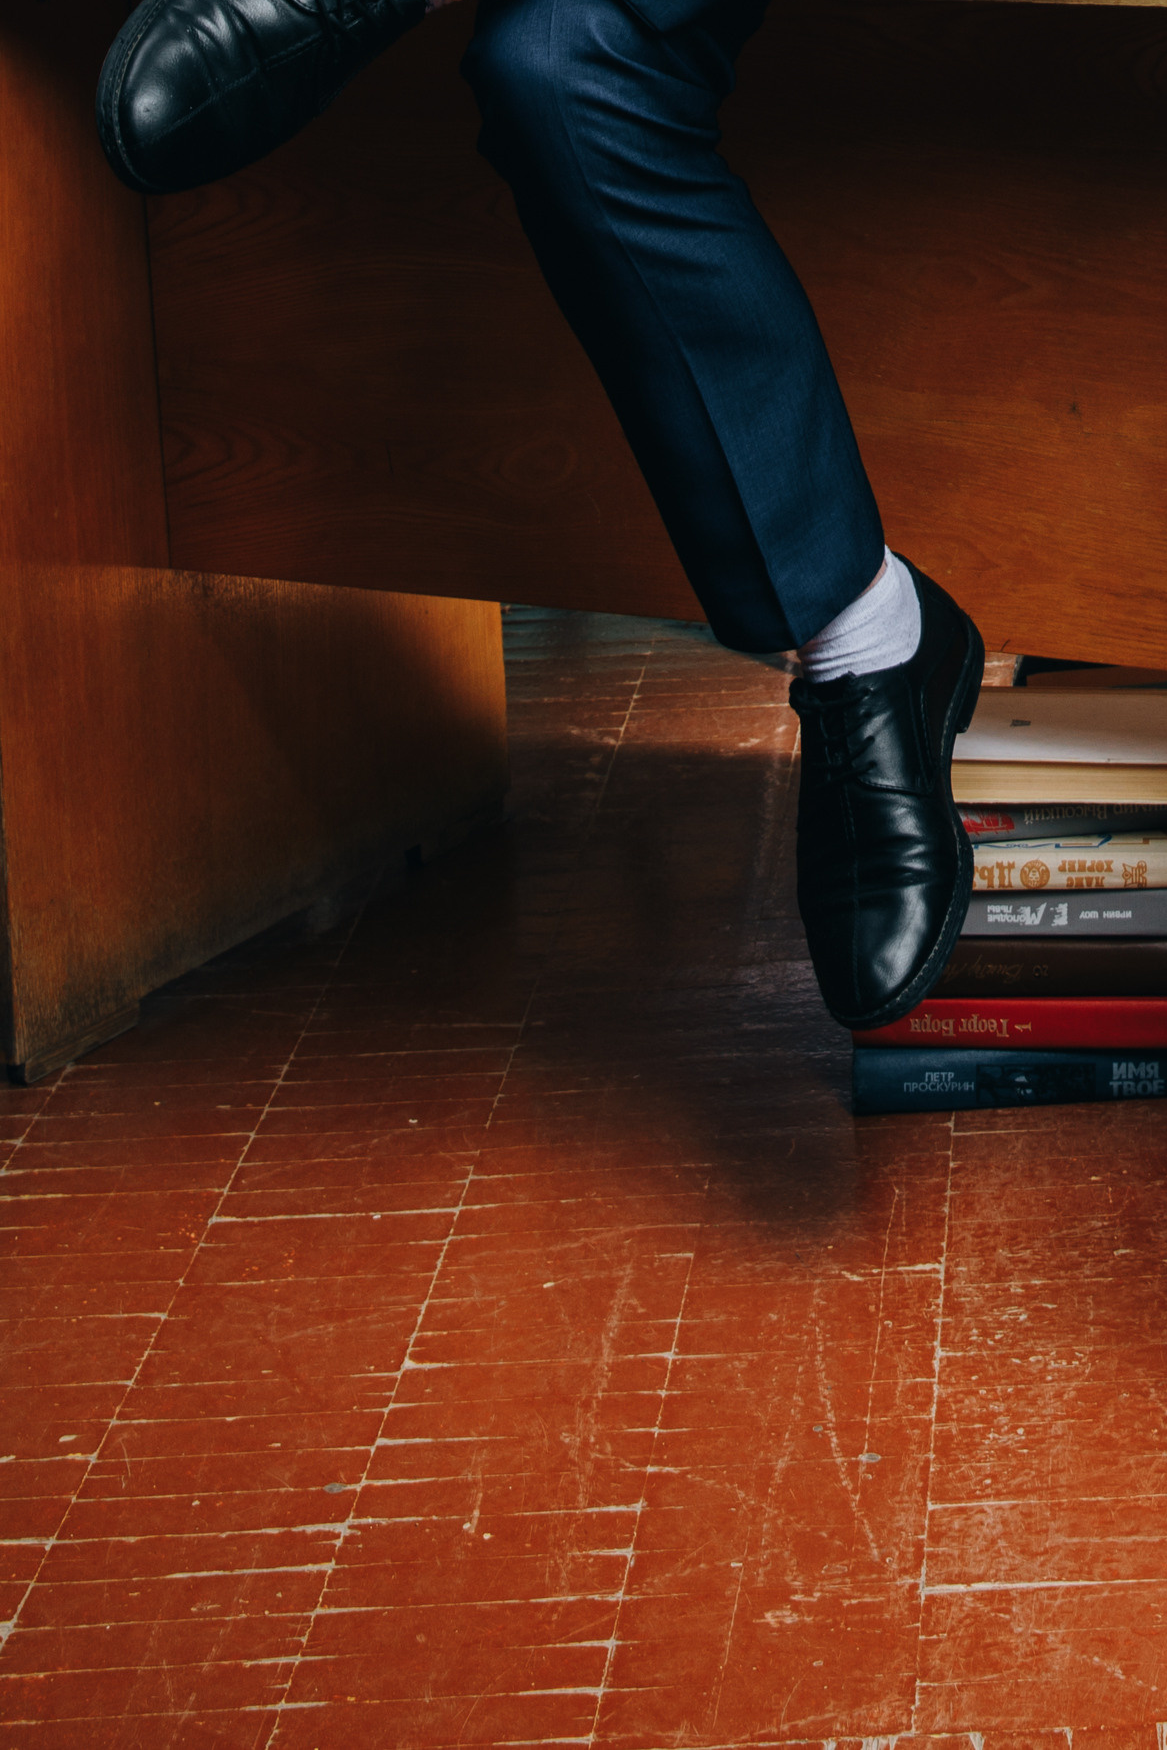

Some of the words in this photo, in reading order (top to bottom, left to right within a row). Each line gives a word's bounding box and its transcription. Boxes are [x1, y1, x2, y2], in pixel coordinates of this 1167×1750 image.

[1058, 859, 1115, 873] ХОРНЕР
[1067, 873, 1107, 888] ЛАНС
[1079, 910, 1099, 919] ШОУ
[1103, 909, 1133, 919] ИРВИН
[910, 1013, 956, 1037] Борн
[959, 1017, 1010, 1037] Георг
[924, 1070, 956, 1082] ПЕТР
[1112, 1062, 1160, 1080] ИМЯ
[903, 1080, 975, 1094] ПРОСКУРИН
[1109, 1079, 1165, 1097] ТВОЕ
